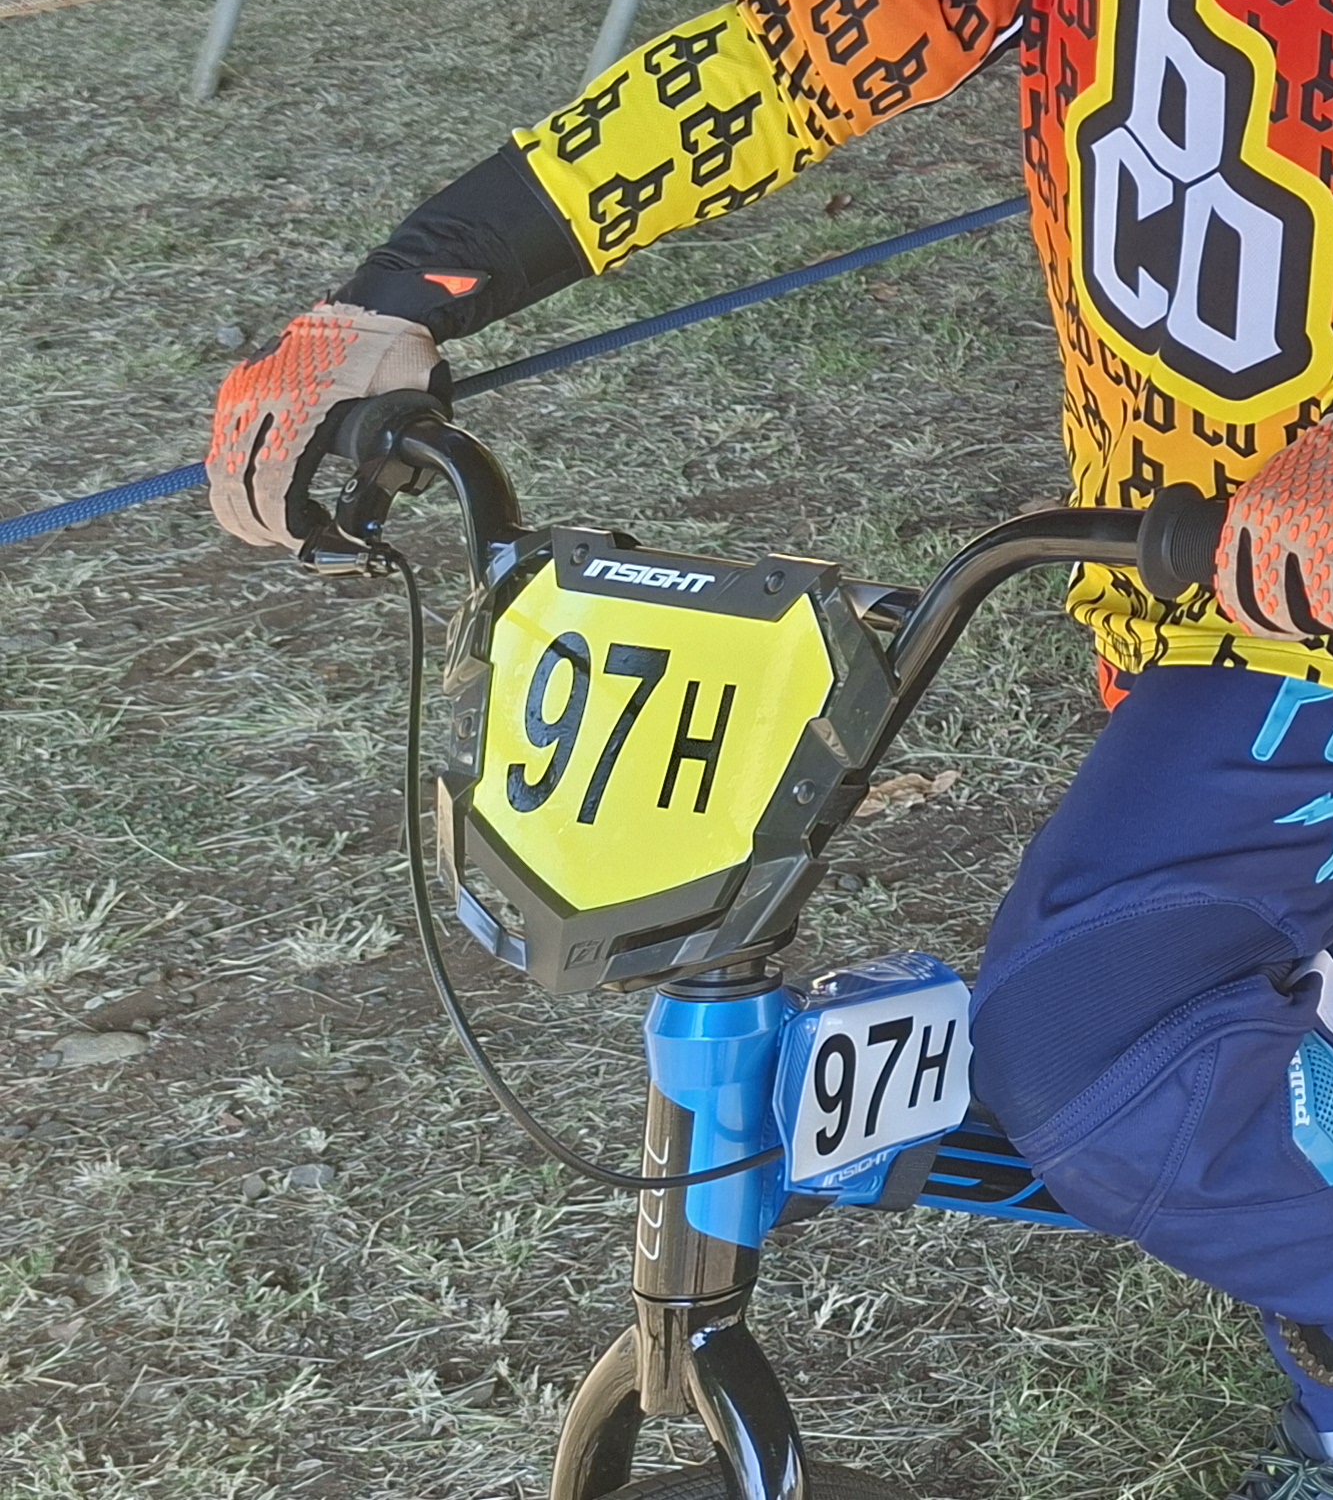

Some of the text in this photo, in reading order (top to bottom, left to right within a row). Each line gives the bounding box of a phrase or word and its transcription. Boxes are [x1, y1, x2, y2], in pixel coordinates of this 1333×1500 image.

[583, 558, 716, 594] INSIGHT
[506, 631, 738, 826] 97H
[813, 1015, 958, 1157] 97H
[822, 1149, 890, 1188] INSIGHT
